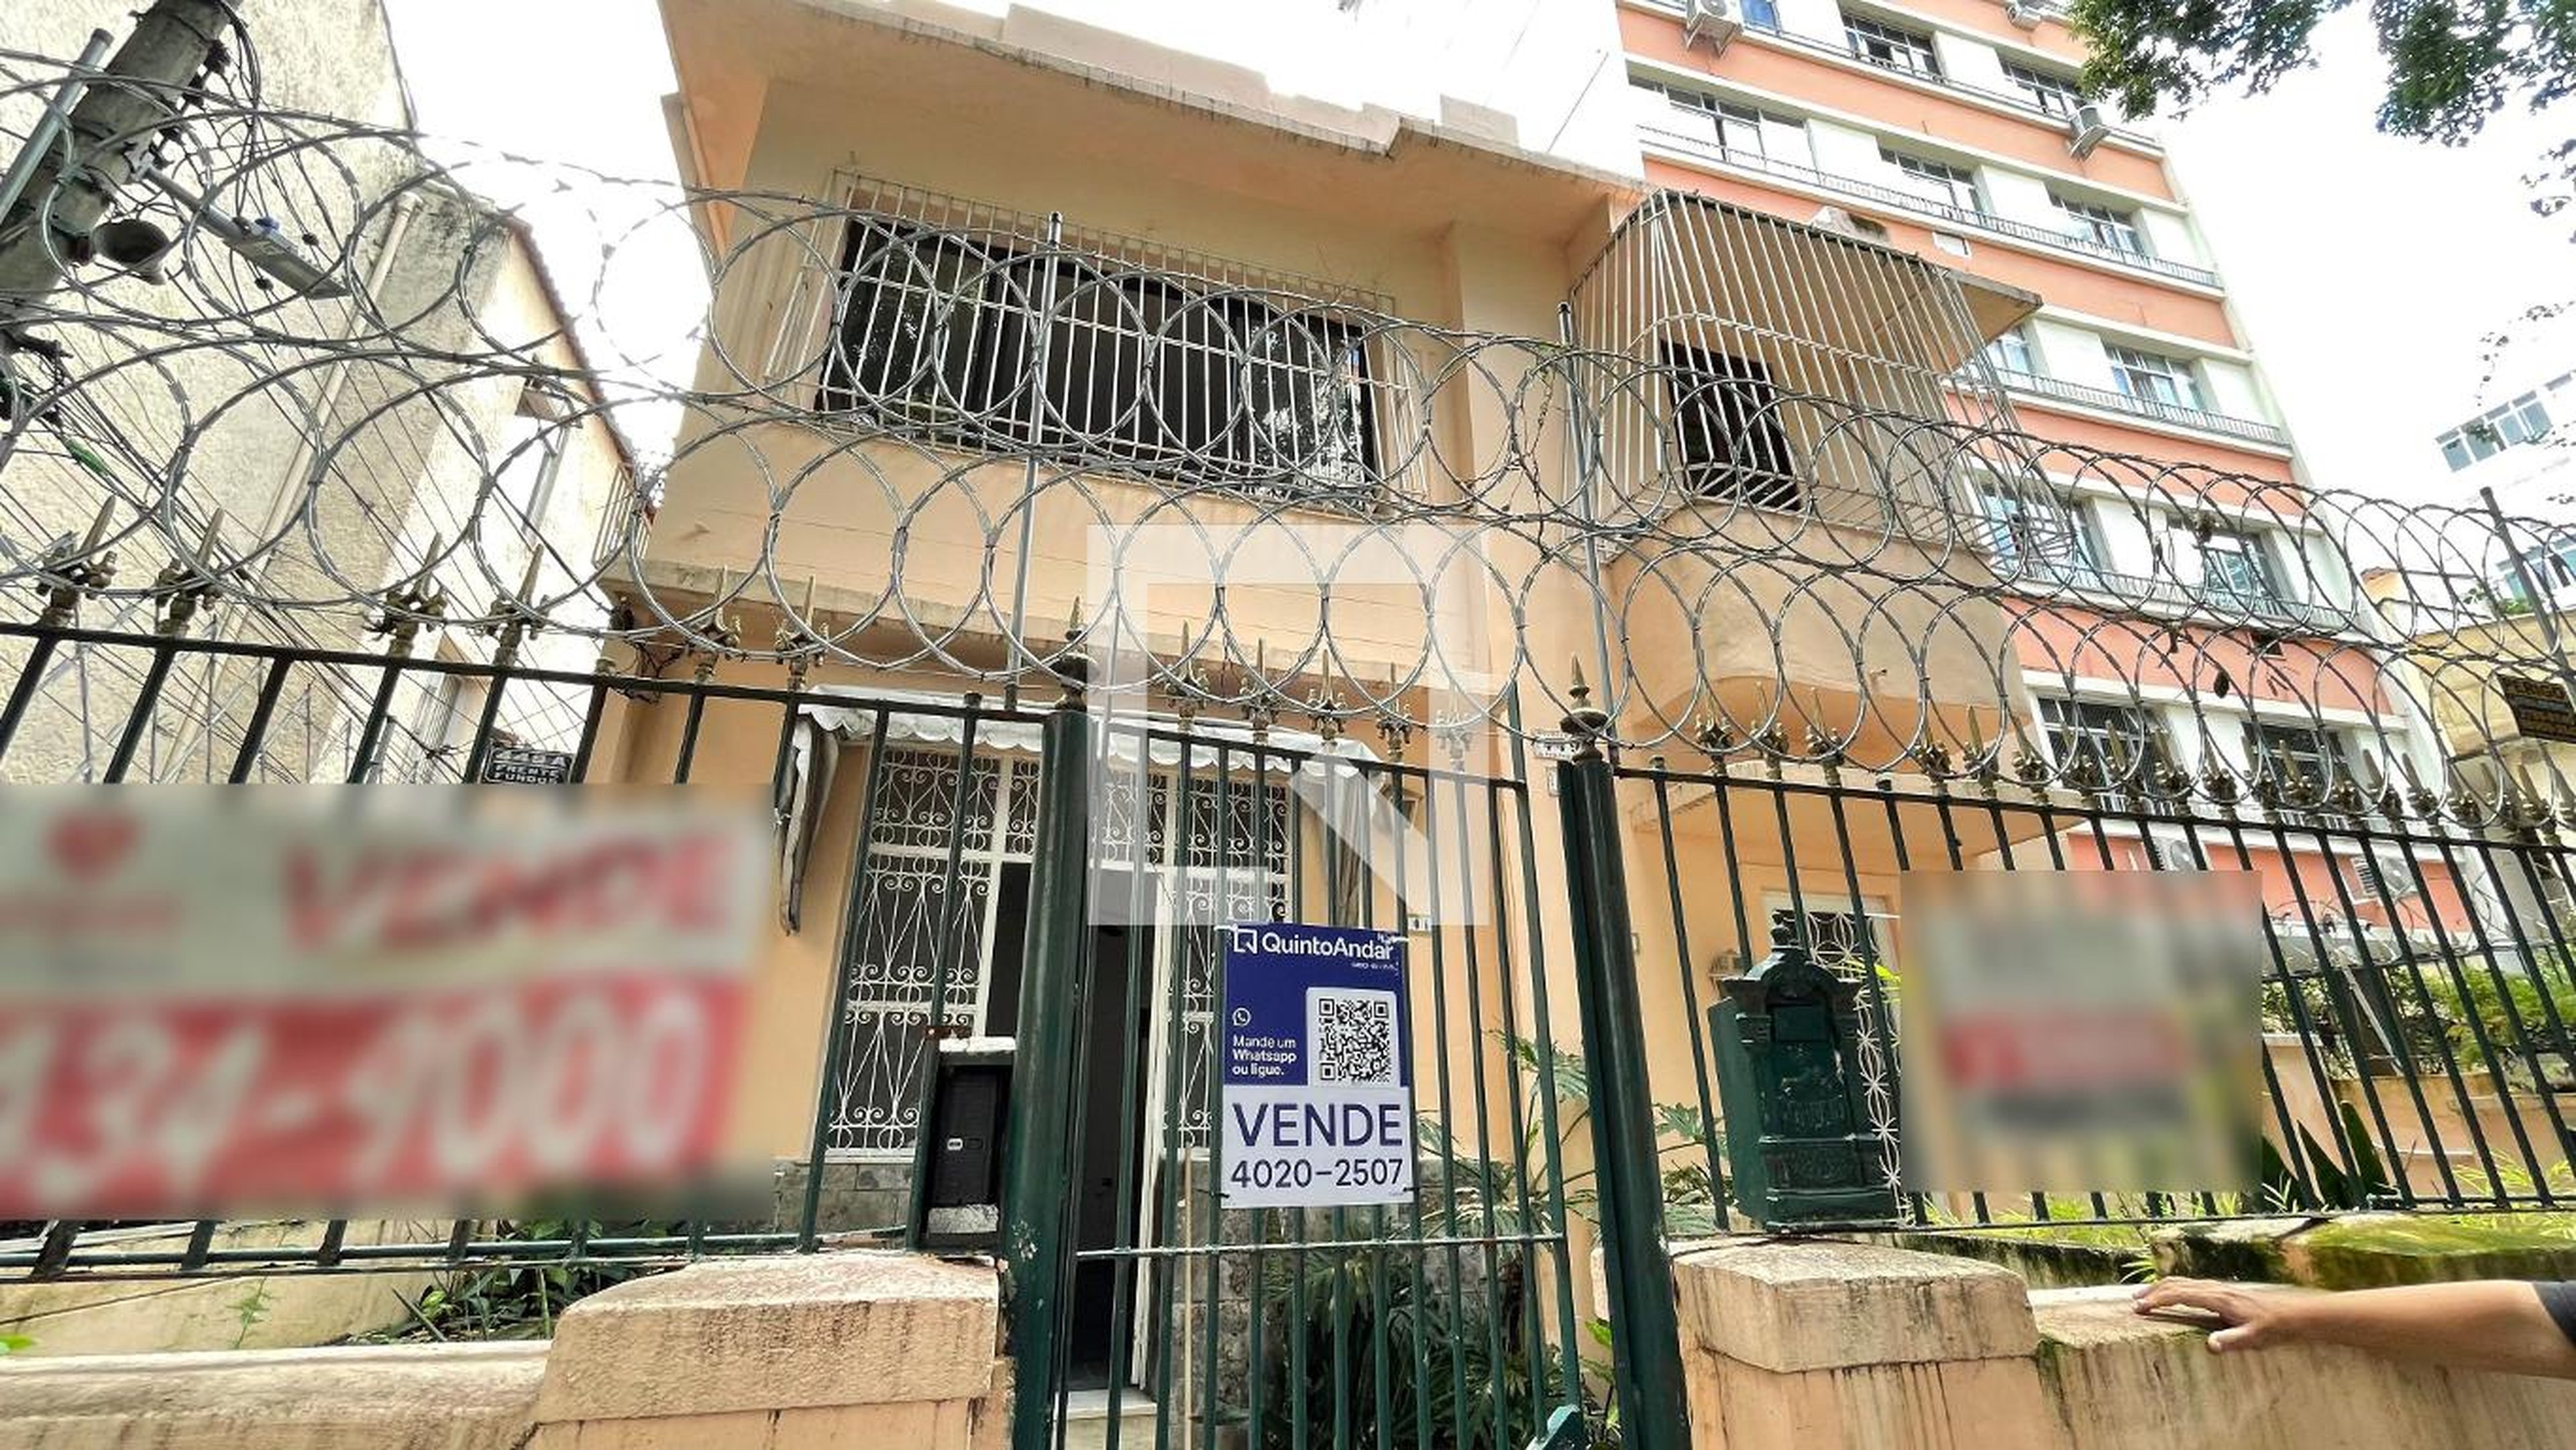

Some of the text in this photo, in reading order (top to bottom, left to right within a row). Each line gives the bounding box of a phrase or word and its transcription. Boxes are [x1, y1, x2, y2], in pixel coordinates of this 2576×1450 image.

[1262, 932, 1393, 960] QuintoAndar
[1232, 1034, 1296, 1048] Mande um
[1232, 1049, 1297, 1064] Whatsapp
[1232, 1063, 1285, 1078] ou ligue.
[1233, 1103, 1403, 1147] VENDE
[1232, 1158, 1403, 1188] 4020-2507
